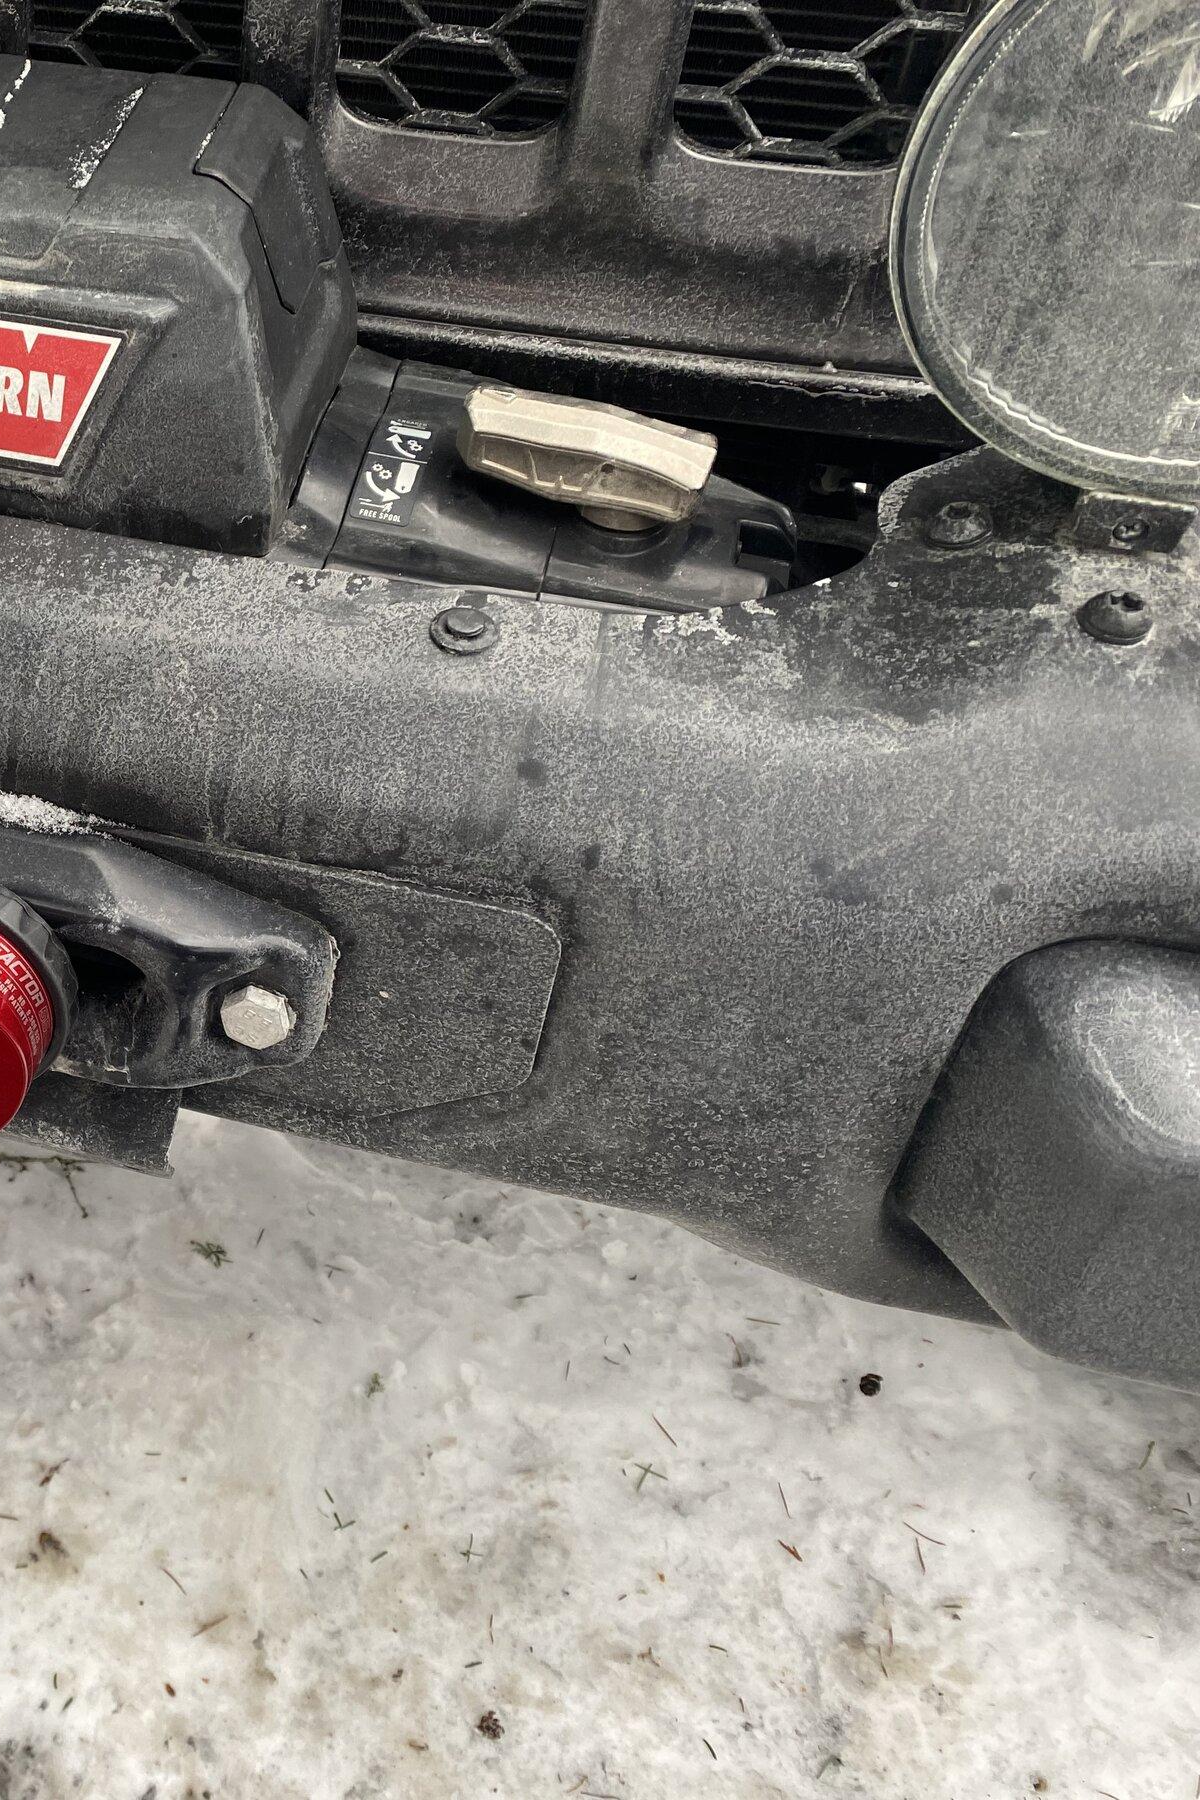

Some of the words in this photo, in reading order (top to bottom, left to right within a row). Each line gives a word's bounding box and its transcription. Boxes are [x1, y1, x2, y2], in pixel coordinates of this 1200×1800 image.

[359, 508, 377, 518] FREE
[378, 511, 401, 523] SPOOL
[8, 995, 29, 1026] PATENTS
